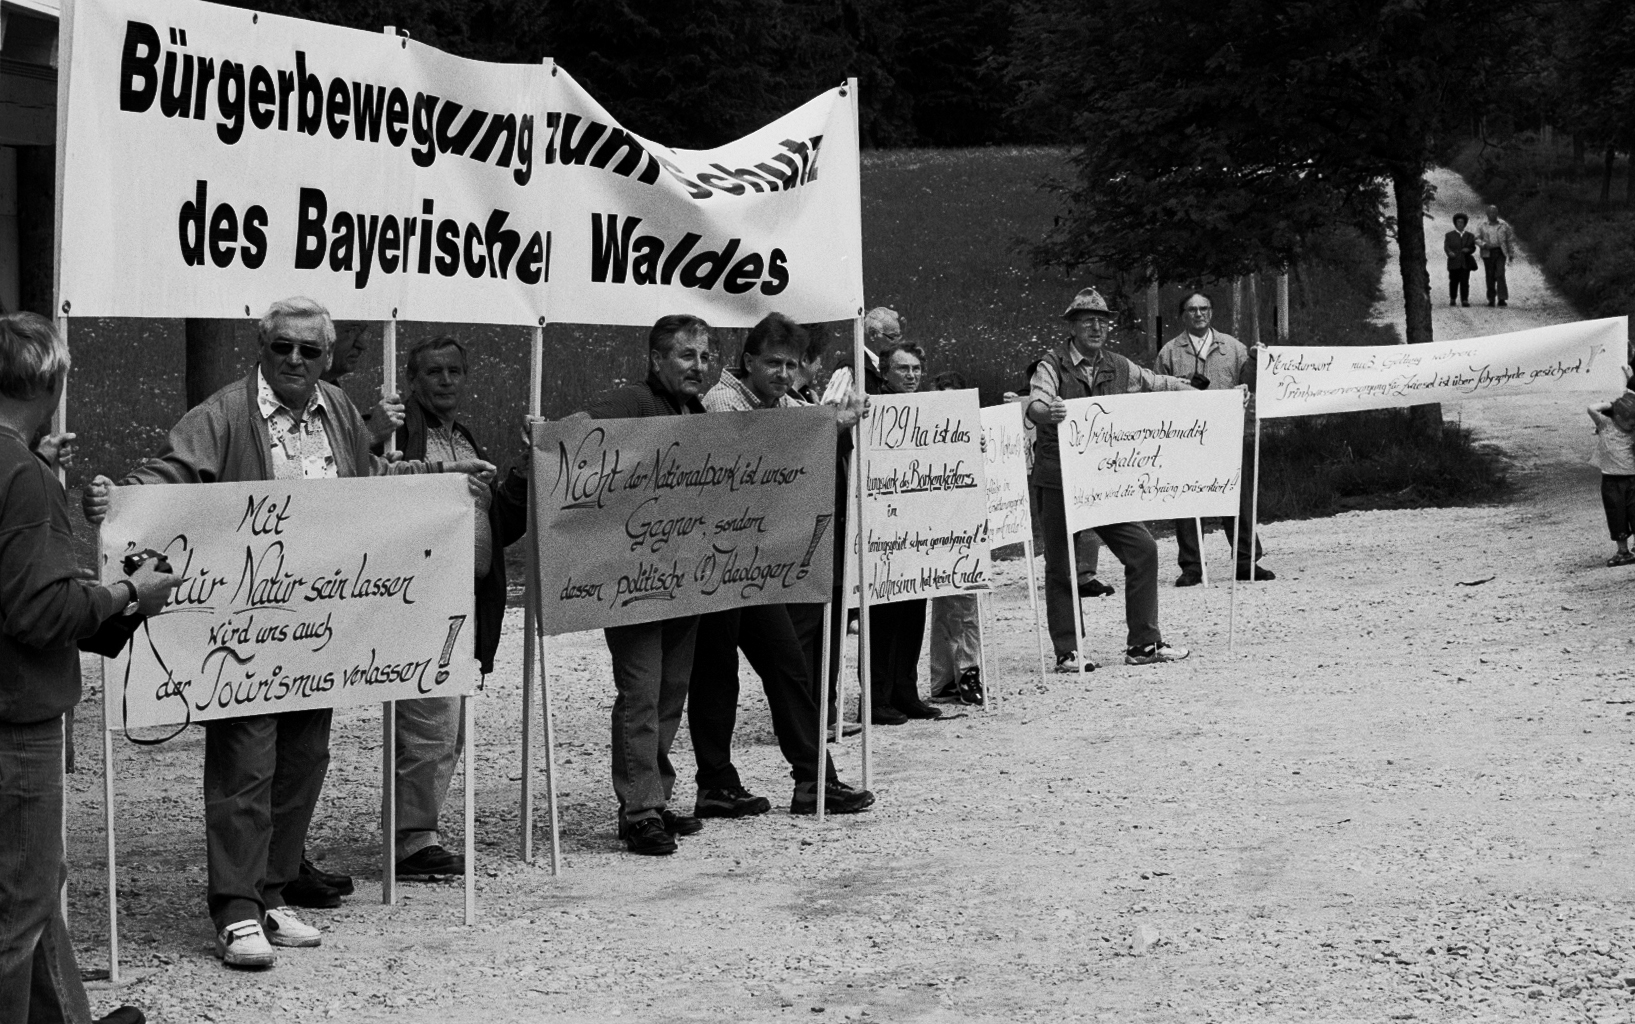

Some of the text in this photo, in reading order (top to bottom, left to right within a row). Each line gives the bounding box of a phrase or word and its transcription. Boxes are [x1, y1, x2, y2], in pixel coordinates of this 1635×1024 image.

[120, 20, 823, 199] Bürgerbewegung zum Schutz
[178, 180, 790, 296] des Bayerische Waldes
[1438, 374, 1450, 387] ist
[1451, 373, 1475, 387] über
[869, 405, 971, 448] 1129 ha ist das
[1069, 420, 1085, 447] Die
[550, 427, 806, 509] Nicht der Nationalpark ist unser
[1120, 484, 1136, 498] die
[237, 494, 292, 537] Mit
[714, 506, 767, 535] sondern
[887, 504, 898, 517] in
[909, 531, 928, 552] schon
[304, 568, 348, 603] sein
[560, 577, 605, 601] dessen
[610, 560, 685, 609] politische
[919, 567, 932, 591] hat
[932, 568, 951, 589] kein
[208, 612, 334, 652] wird uns auch
[156, 669, 193, 701] der
[195, 646, 335, 711] Tourismus
